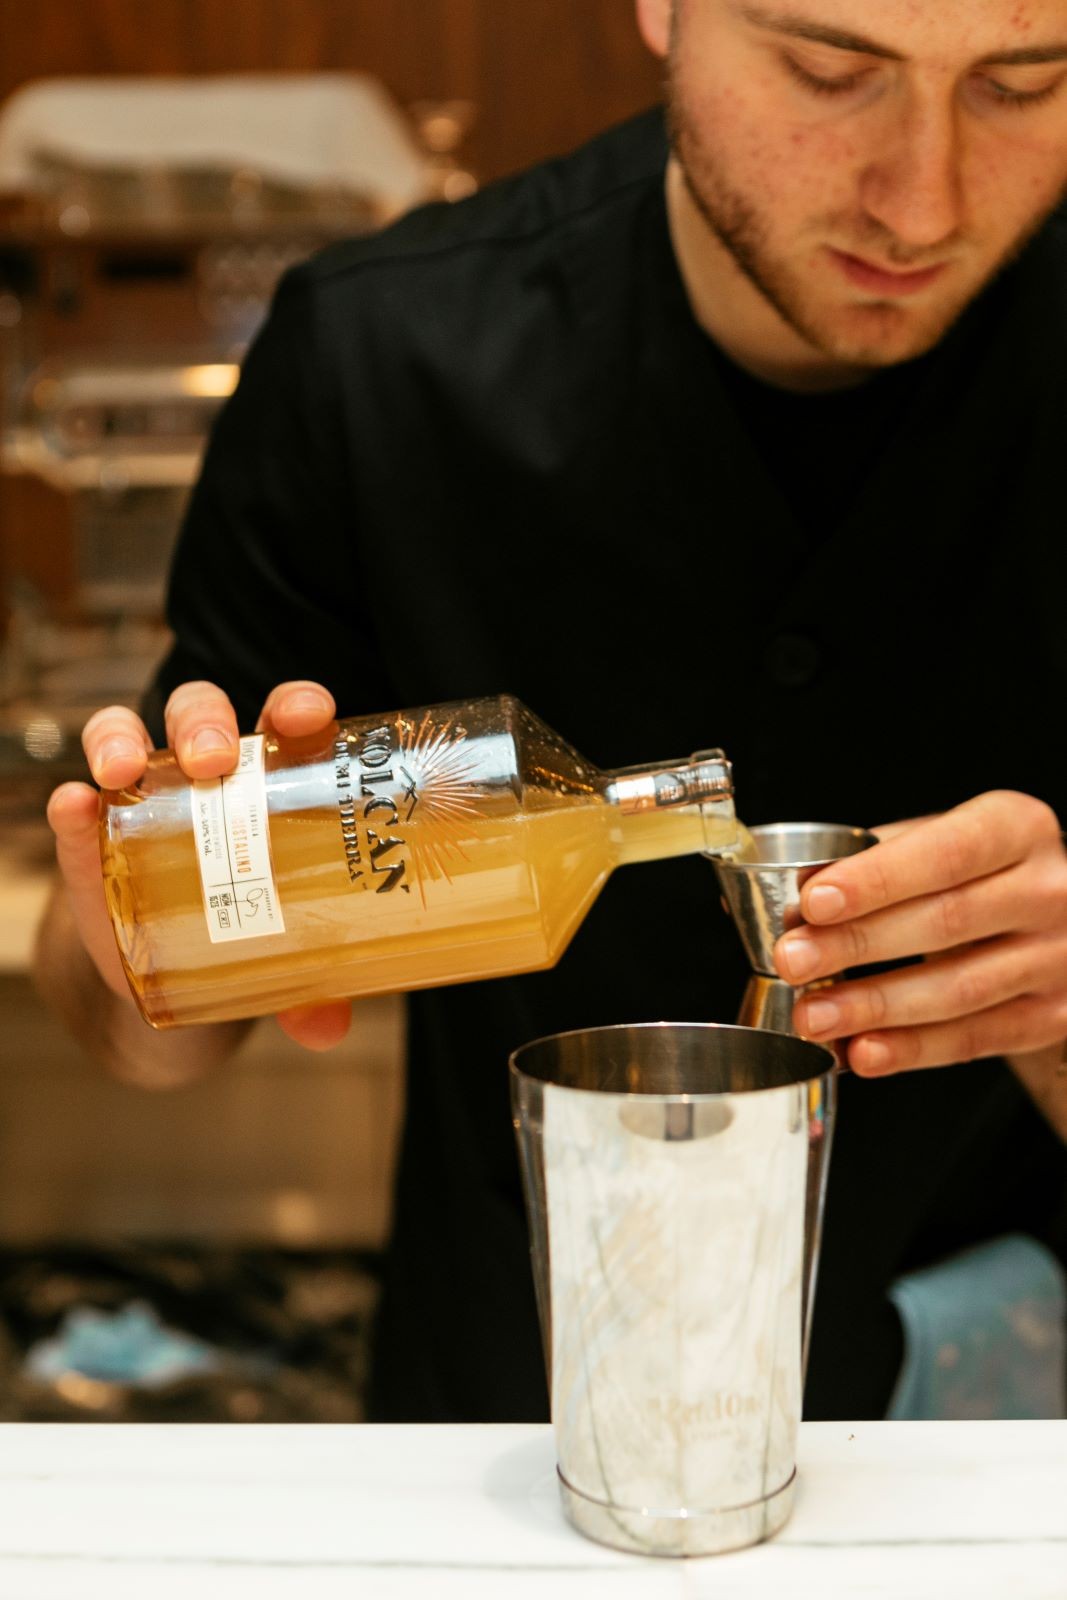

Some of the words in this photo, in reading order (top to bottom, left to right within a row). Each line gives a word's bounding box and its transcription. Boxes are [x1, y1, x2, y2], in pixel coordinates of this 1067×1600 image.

[241, 740, 256, 767] 100%
[336, 763, 351, 788] MI
[359, 725, 410, 894] VOLCAN
[202, 819, 210, 838] 40%
[338, 794, 364, 883] TIERRA
[203, 839, 213, 856] Vol.
[221, 893, 231, 906] NOM
